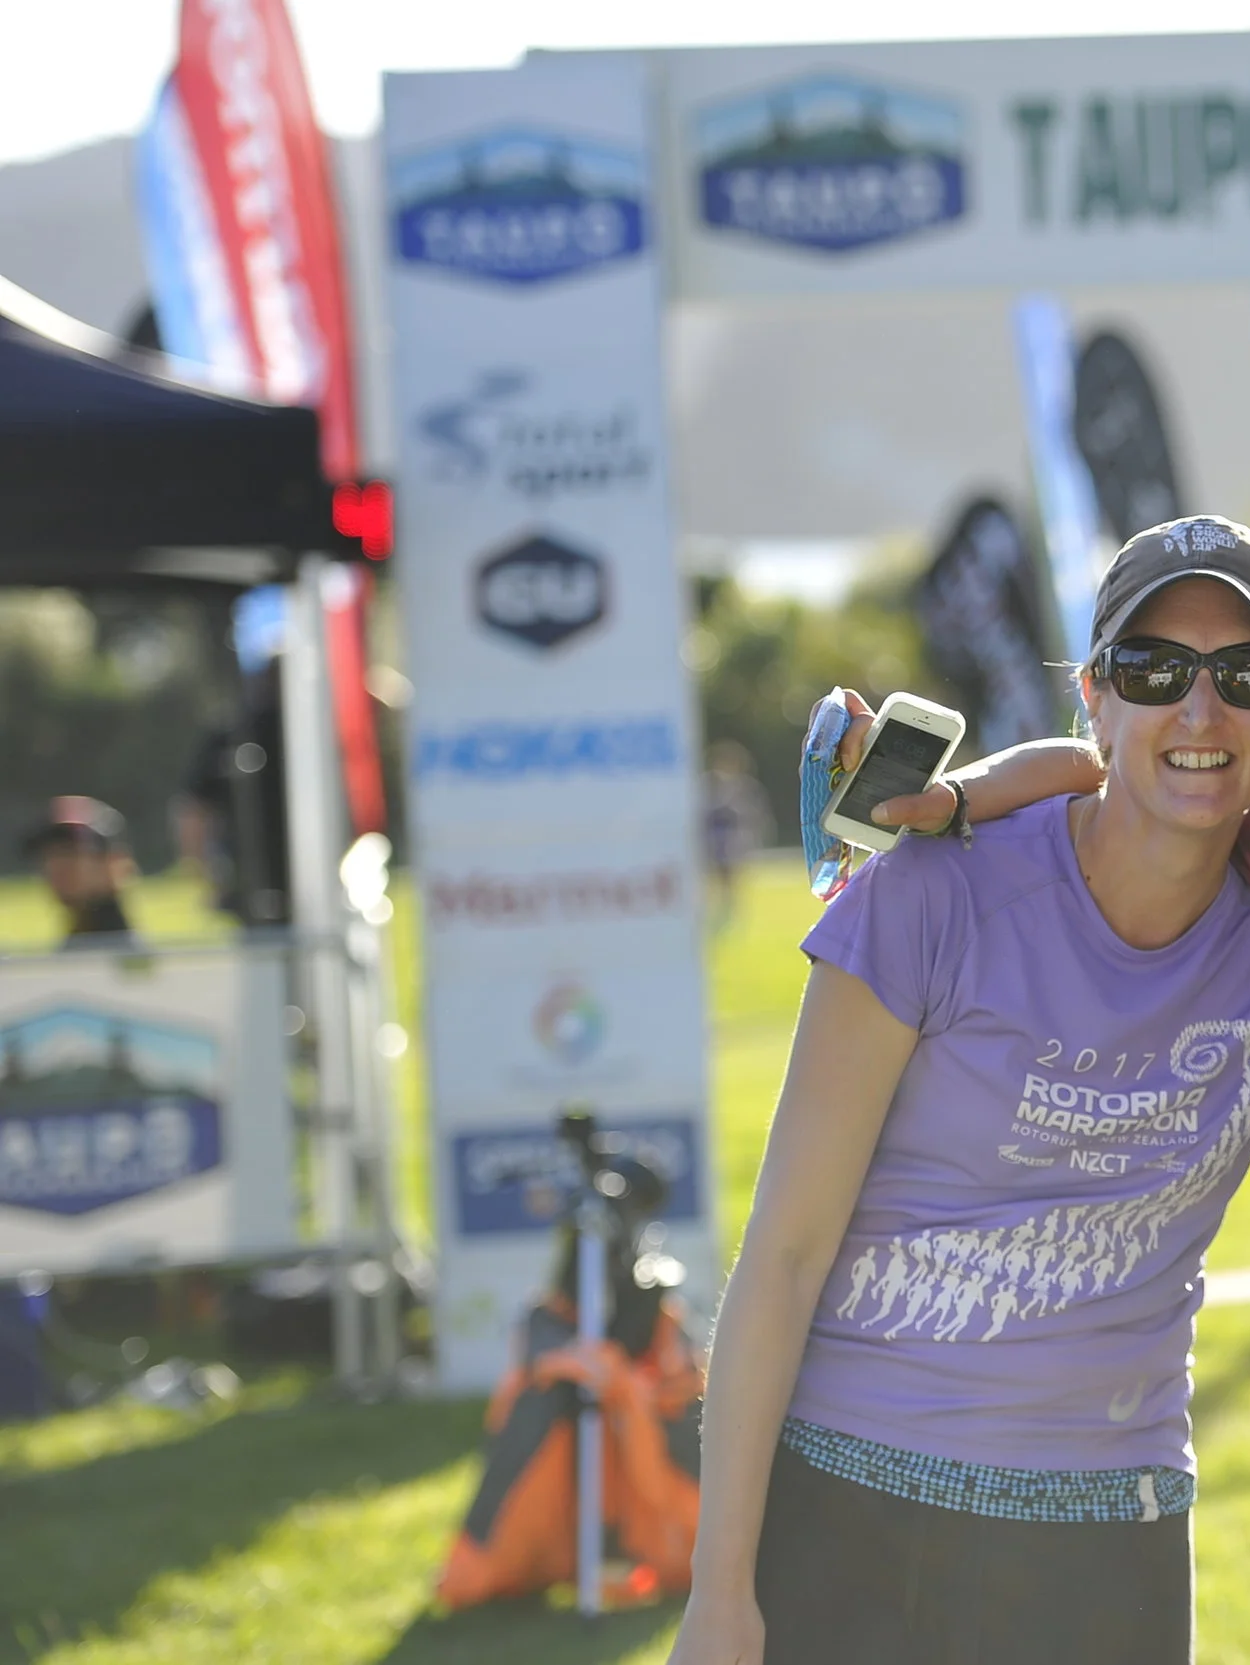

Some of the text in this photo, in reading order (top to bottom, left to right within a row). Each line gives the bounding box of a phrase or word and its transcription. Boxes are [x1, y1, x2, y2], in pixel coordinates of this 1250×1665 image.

[1036, 1039, 1156, 1080] 2017
[1023, 1073, 1206, 1118] ROTORUA
[1011, 1123, 1077, 1148] ROTORUA
[1132, 1134, 1199, 1147] ZEALAND
[1016, 1100, 1198, 1137] MARATHON
[1069, 1150, 1131, 1174] NZCT
